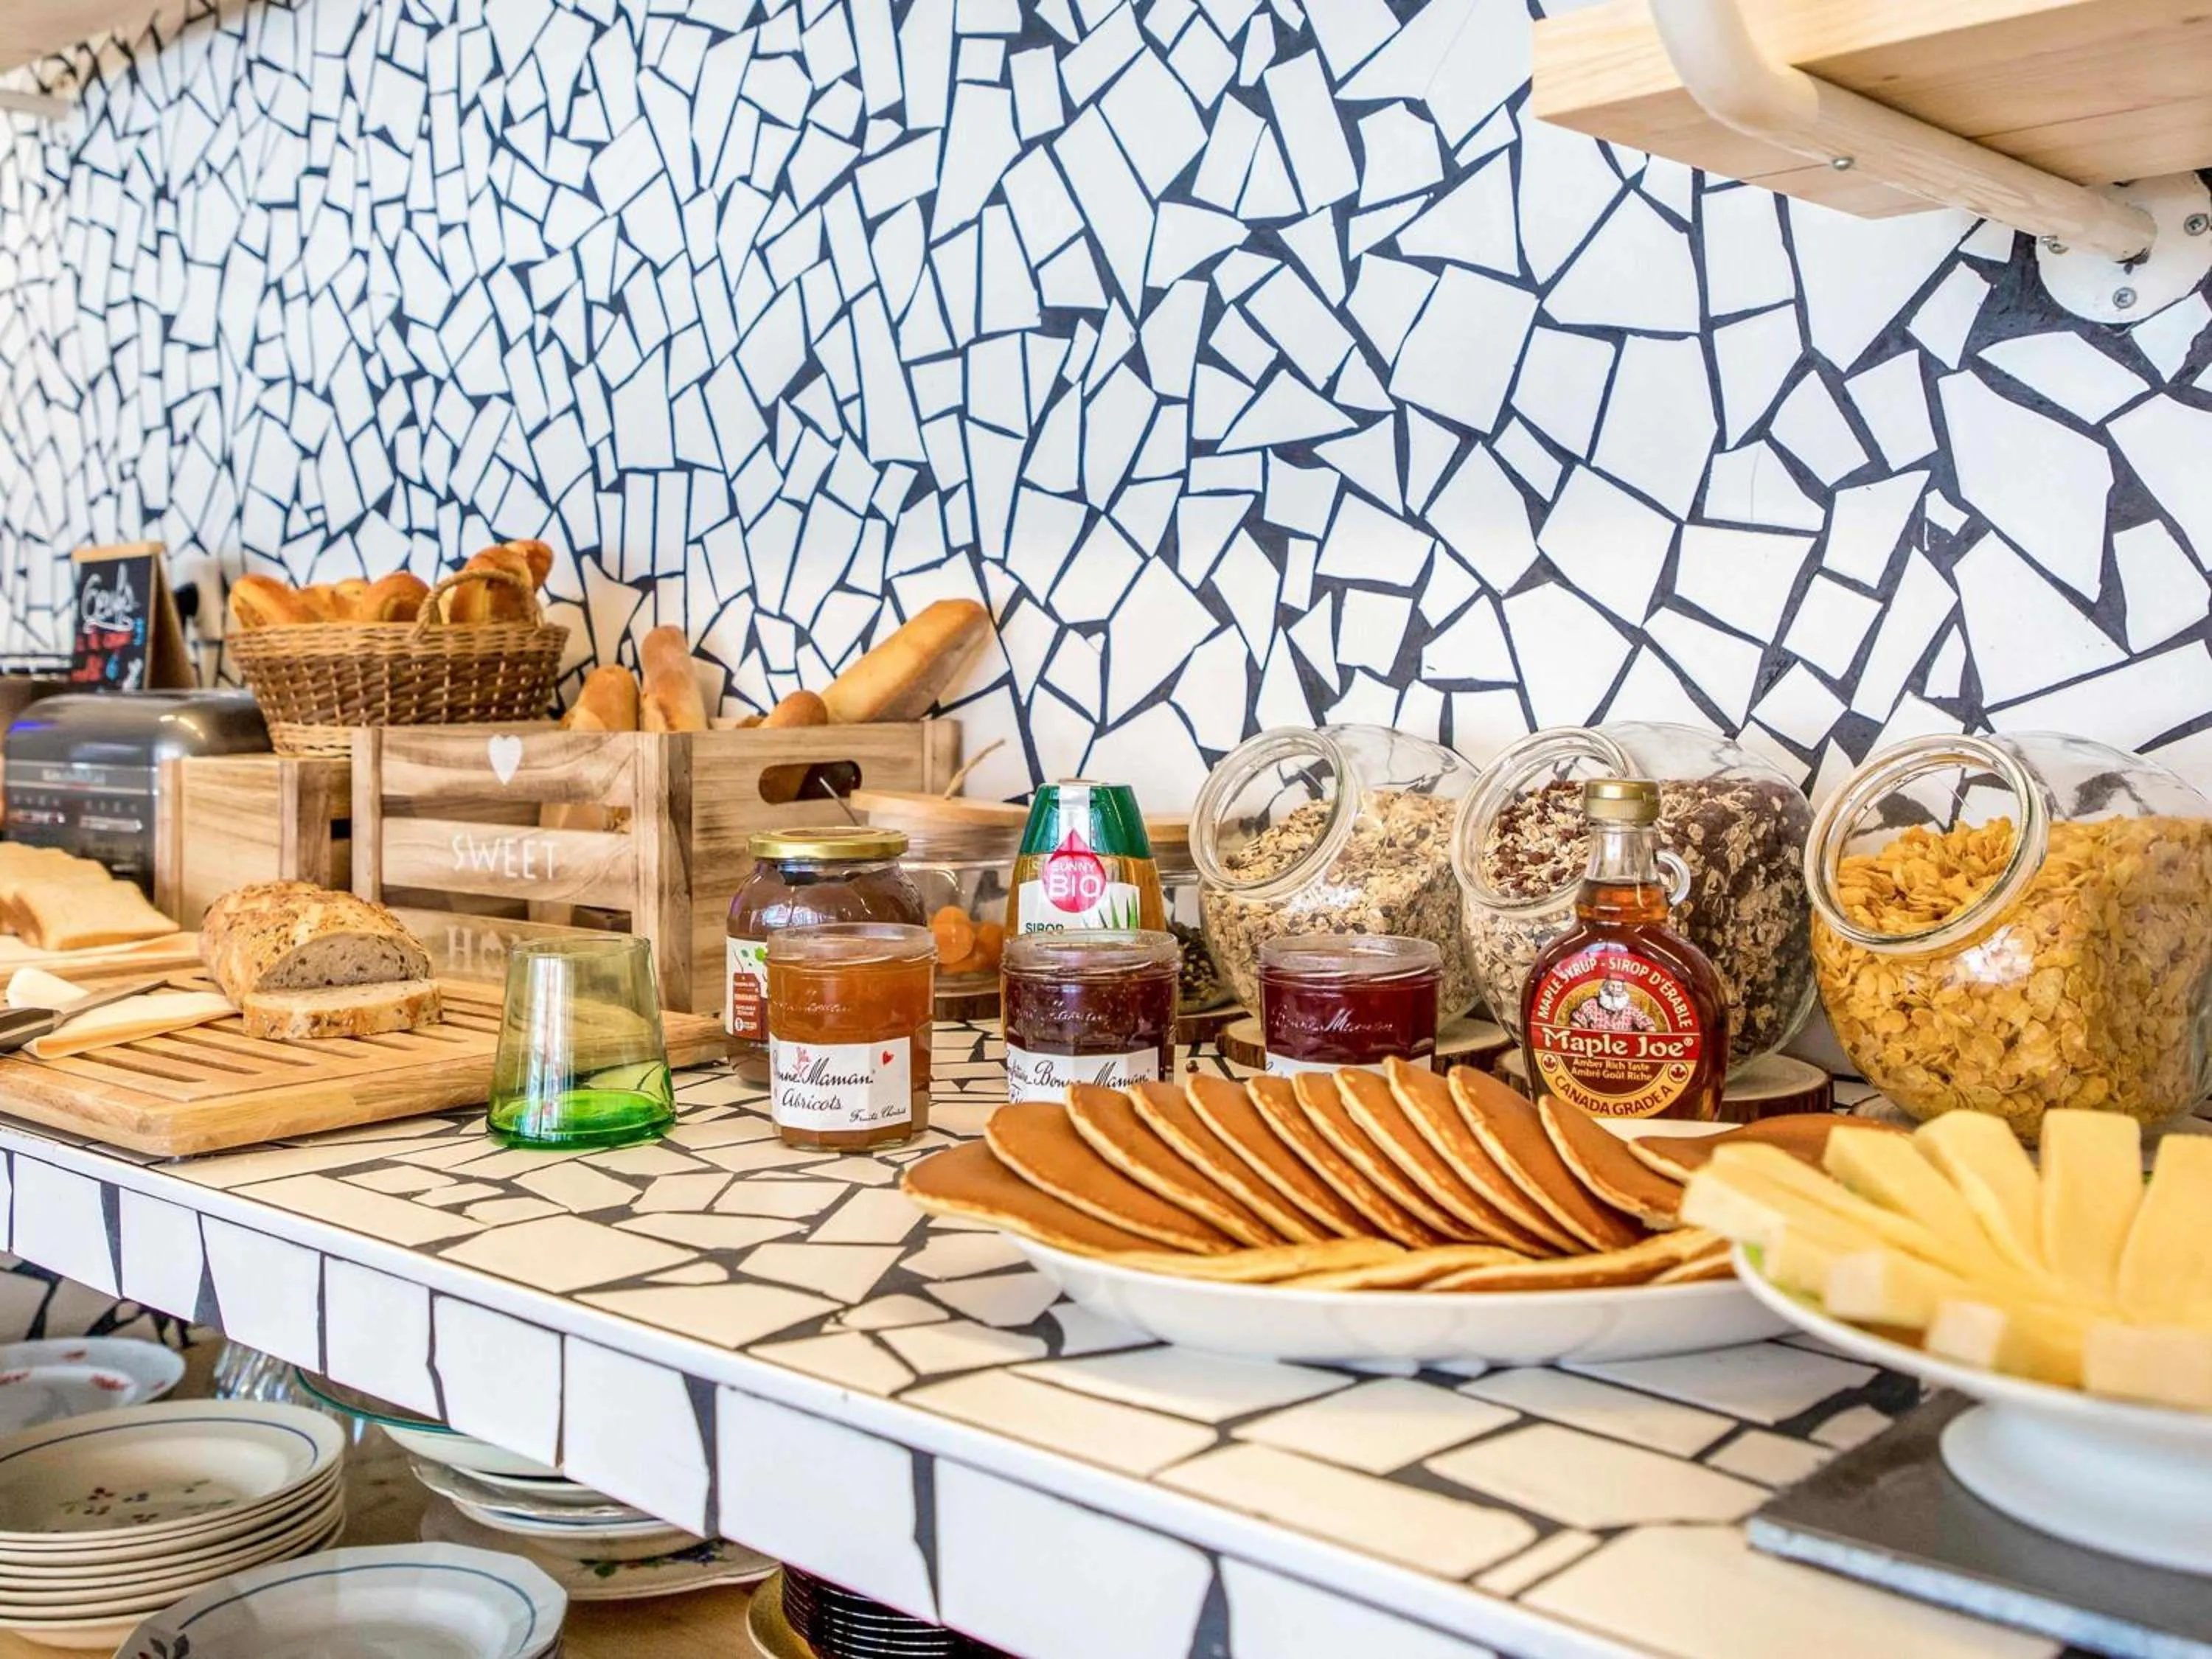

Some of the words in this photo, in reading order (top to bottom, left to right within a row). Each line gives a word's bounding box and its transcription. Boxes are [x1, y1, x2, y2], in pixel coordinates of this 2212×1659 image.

[452, 831, 559, 880] SWEET
[1048, 875, 1102, 897] BIO
[1537, 978, 1563, 1019] MAPLE
[1559, 957, 1598, 984] SYRUP
[1608, 957, 1650, 977] SIROP
[1543, 1027, 1629, 1058] Maple
[1571, 1068, 1601, 1079] Ambré
[1602, 1071, 1625, 1080] Goût
[1627, 1072, 1652, 1081] Riche
[1572, 1057, 1603, 1068] Amber
[1605, 1060, 1626, 1070] Rich
[1629, 1062, 1650, 1071] Taste
[1555, 1076, 1610, 1116] CANADA
[1613, 1093, 1663, 1116] GRADE
[1661, 1085, 1674, 1098] A
